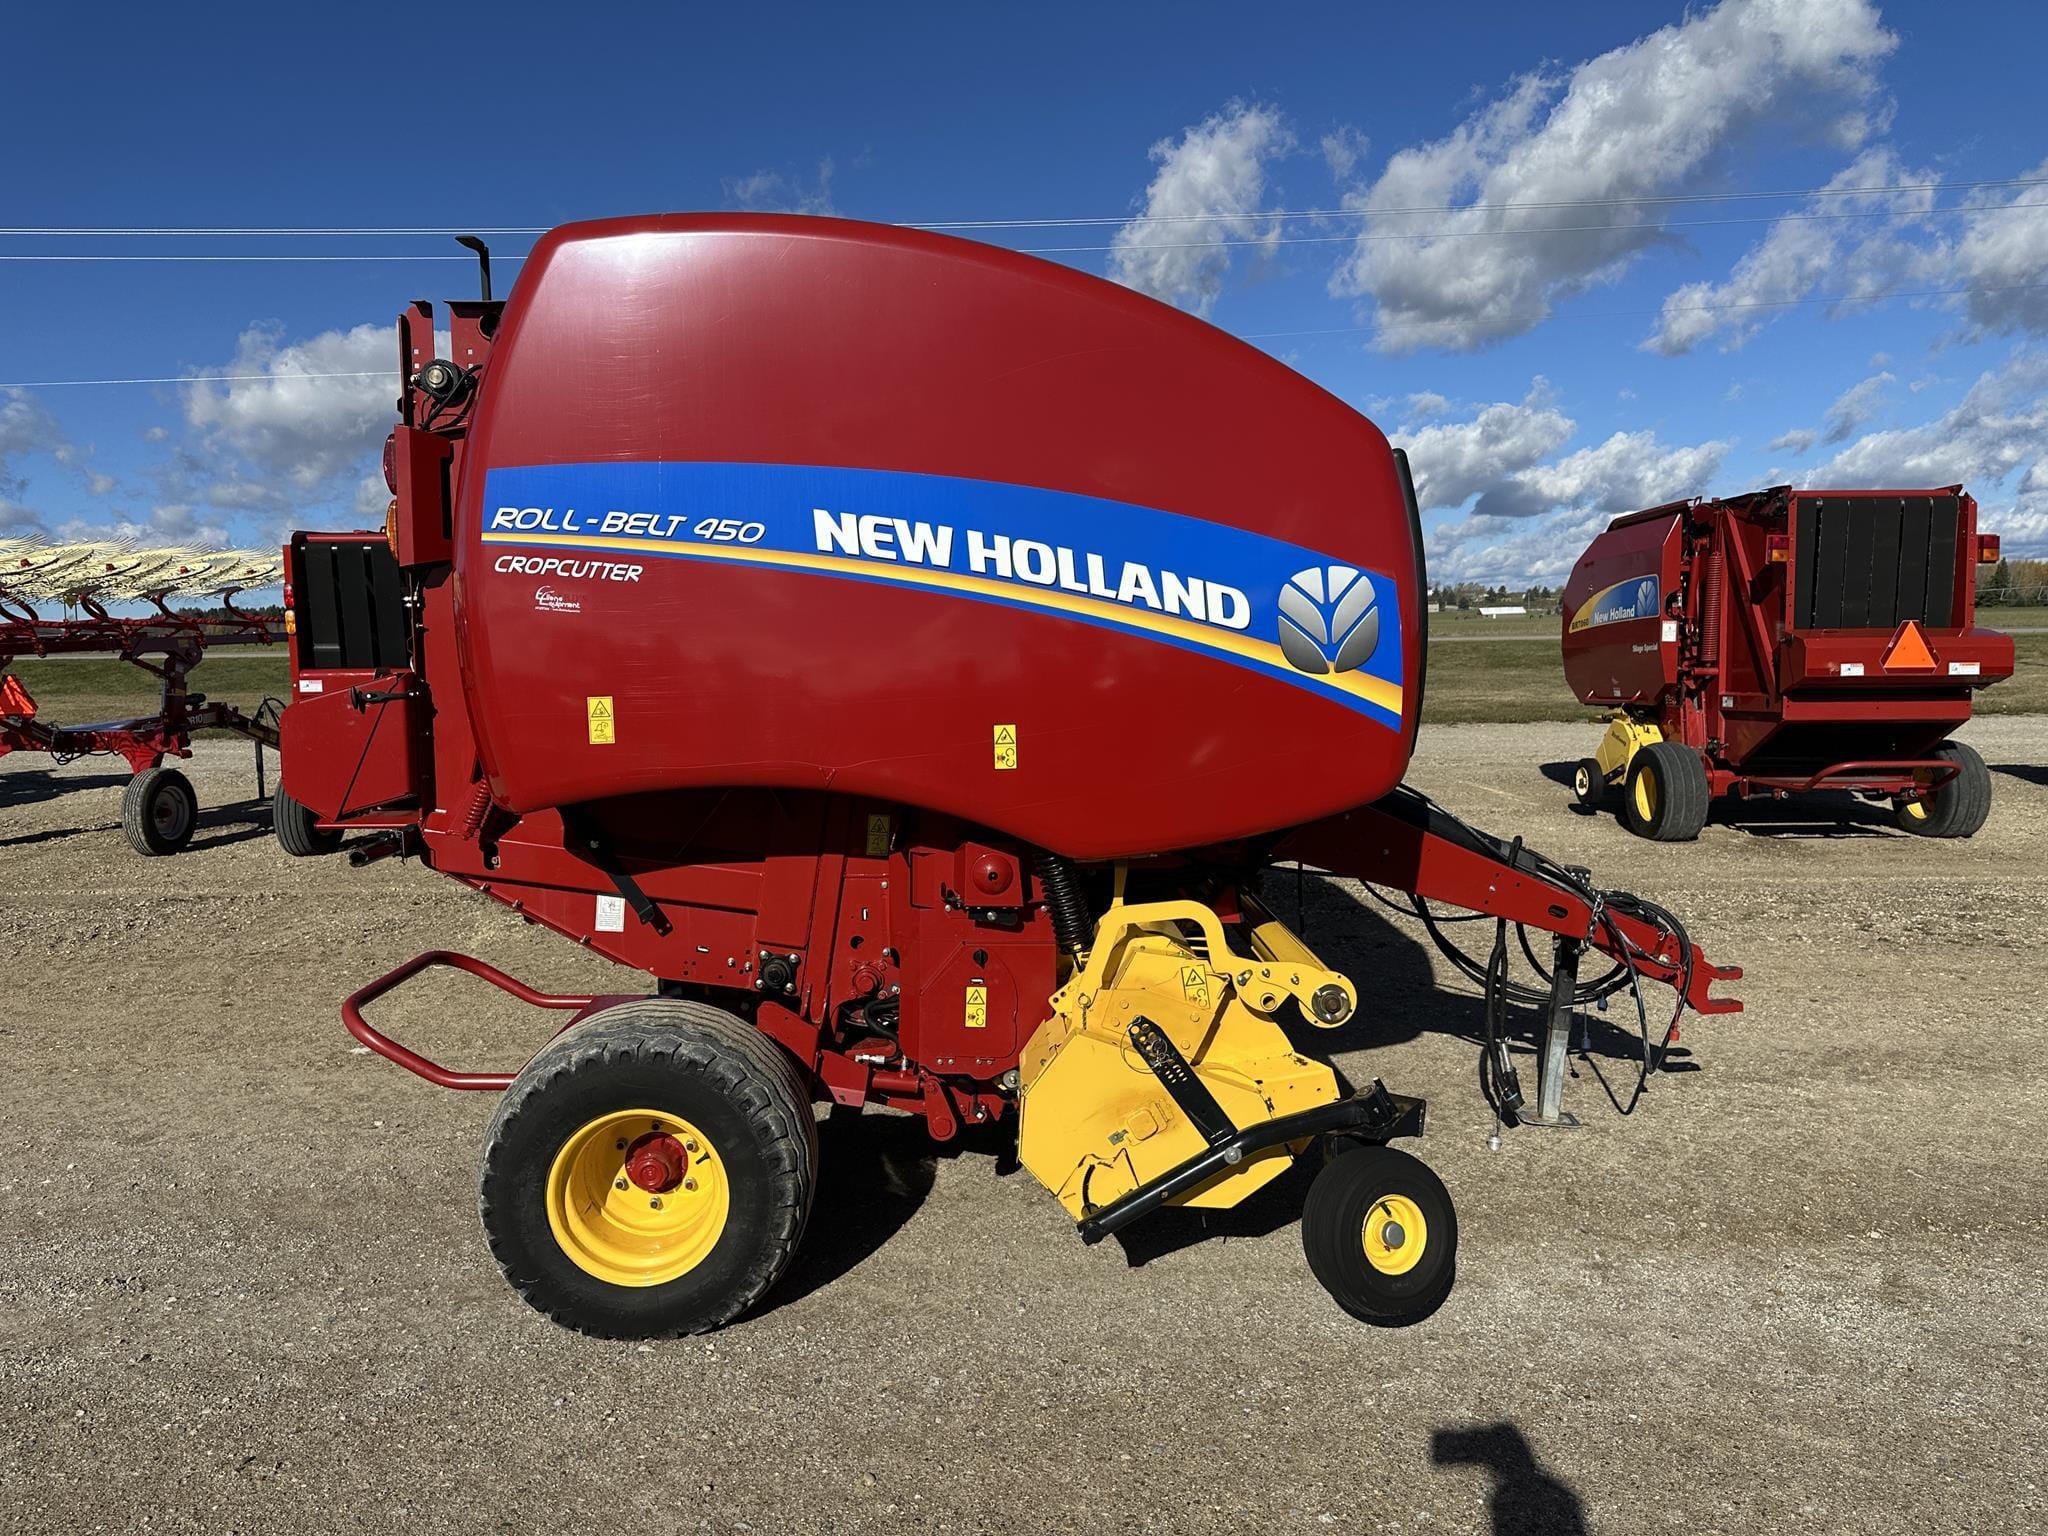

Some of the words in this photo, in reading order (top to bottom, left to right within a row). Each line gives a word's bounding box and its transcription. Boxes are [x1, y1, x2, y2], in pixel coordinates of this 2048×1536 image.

[694, 517, 766, 543] 450
[494, 555, 643, 583] CROPCUTTER
[813, 508, 954, 568] NEW
[966, 529, 1251, 631] HOLLAND
[1594, 611, 1609, 625] New
[1609, 604, 1636, 621] Holland
